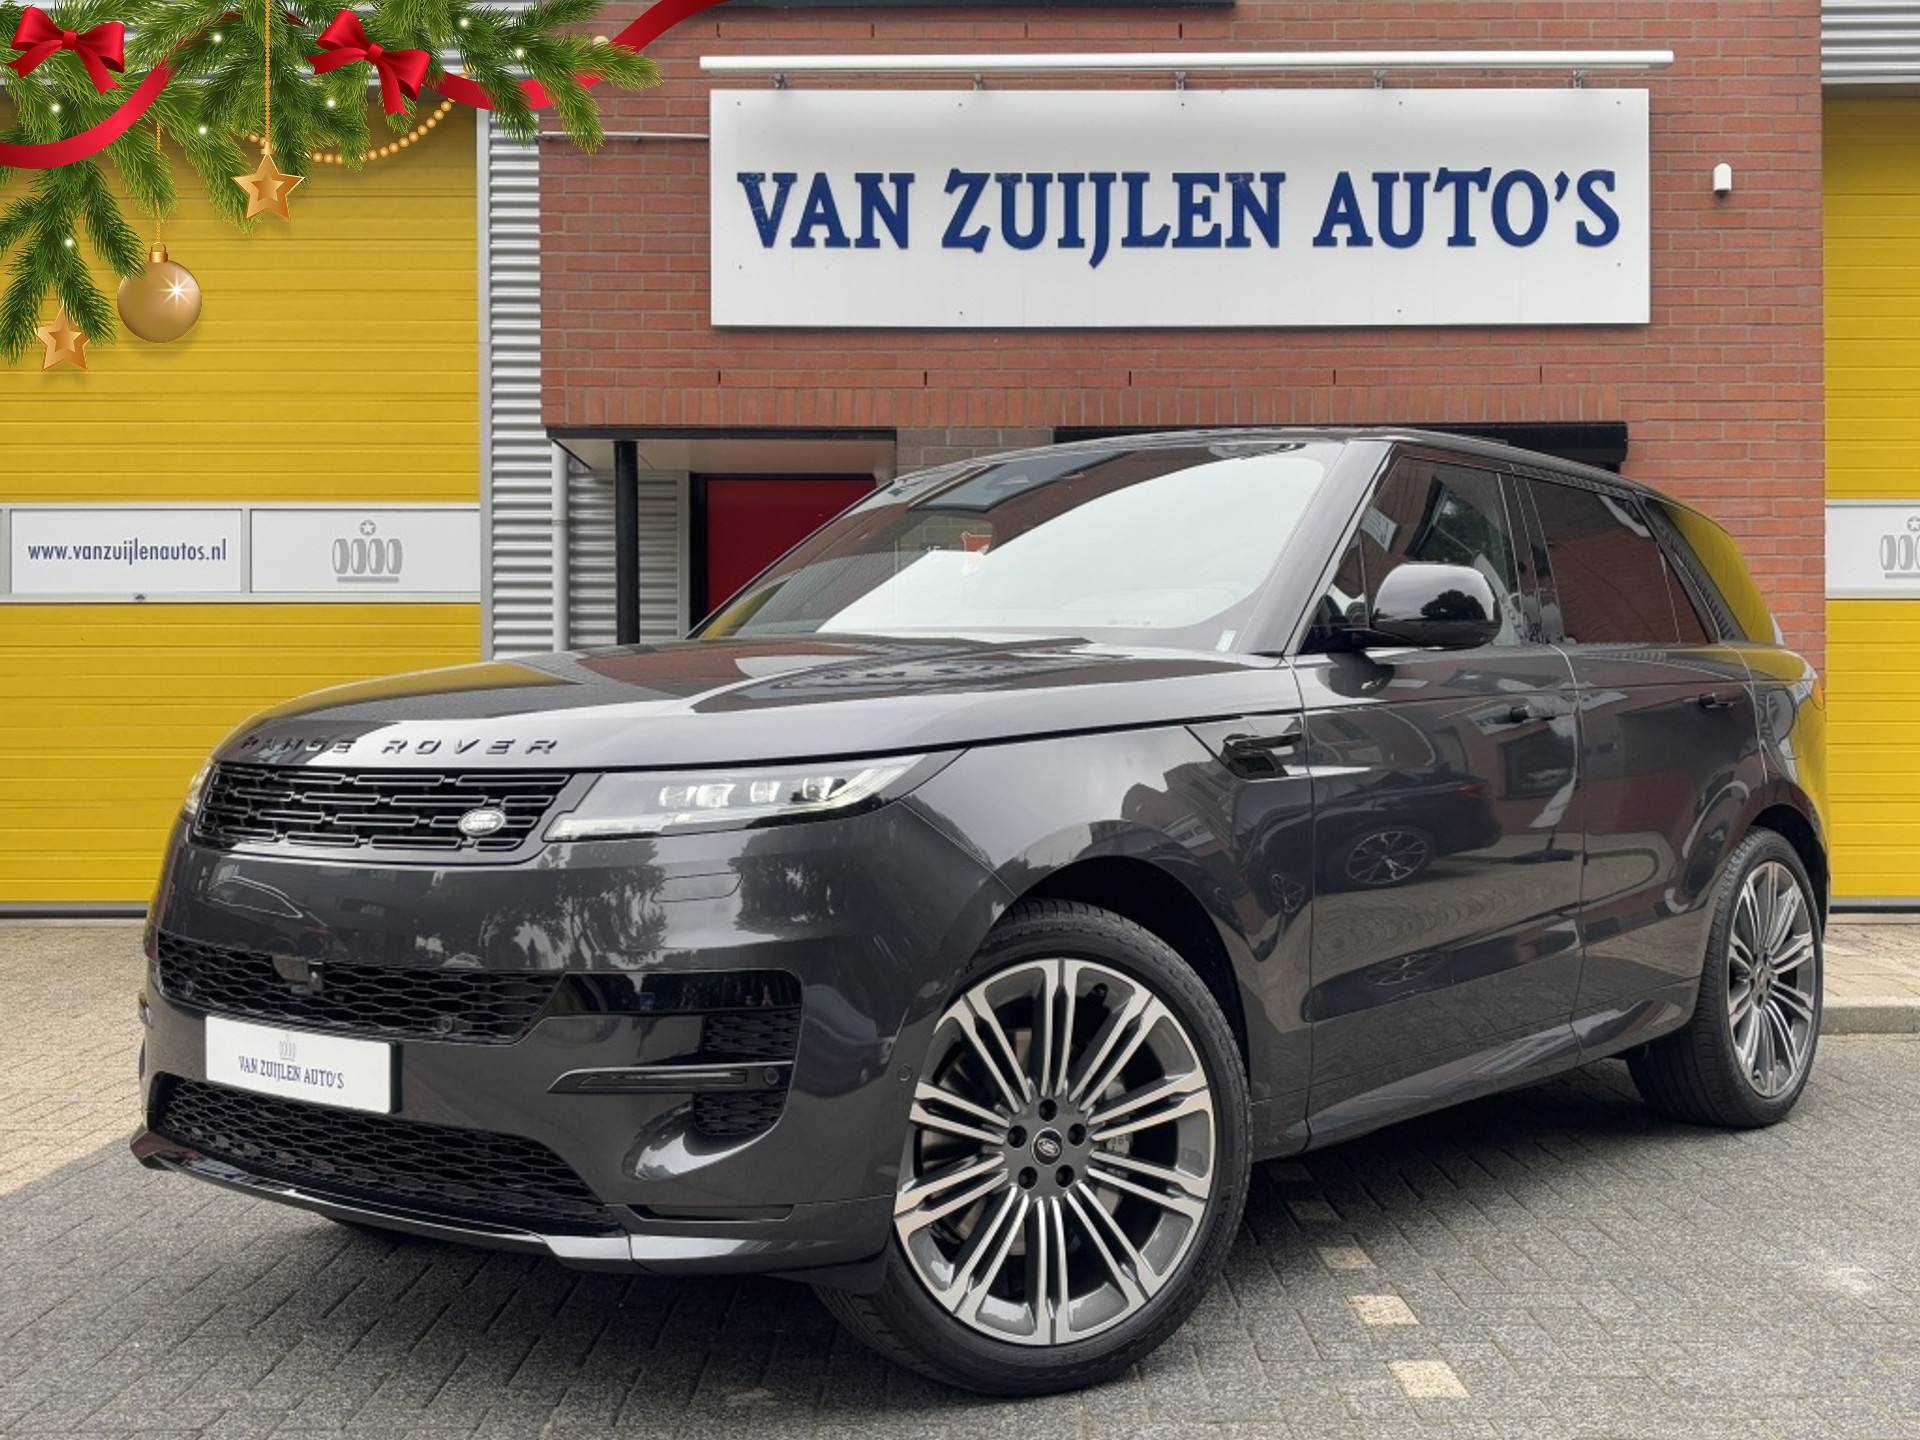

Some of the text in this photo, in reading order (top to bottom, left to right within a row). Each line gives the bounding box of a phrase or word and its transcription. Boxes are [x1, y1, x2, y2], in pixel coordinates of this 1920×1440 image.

[737, 167, 1619, 269] VAN ZUIJLEN AUTO'S
[28, 538, 225, 565] www.vanzuijlenautos.nl
[240, 736, 557, 755] RANGE ROVER
[239, 1056, 343, 1089] VAN ZUIJLEN AUTO'S
